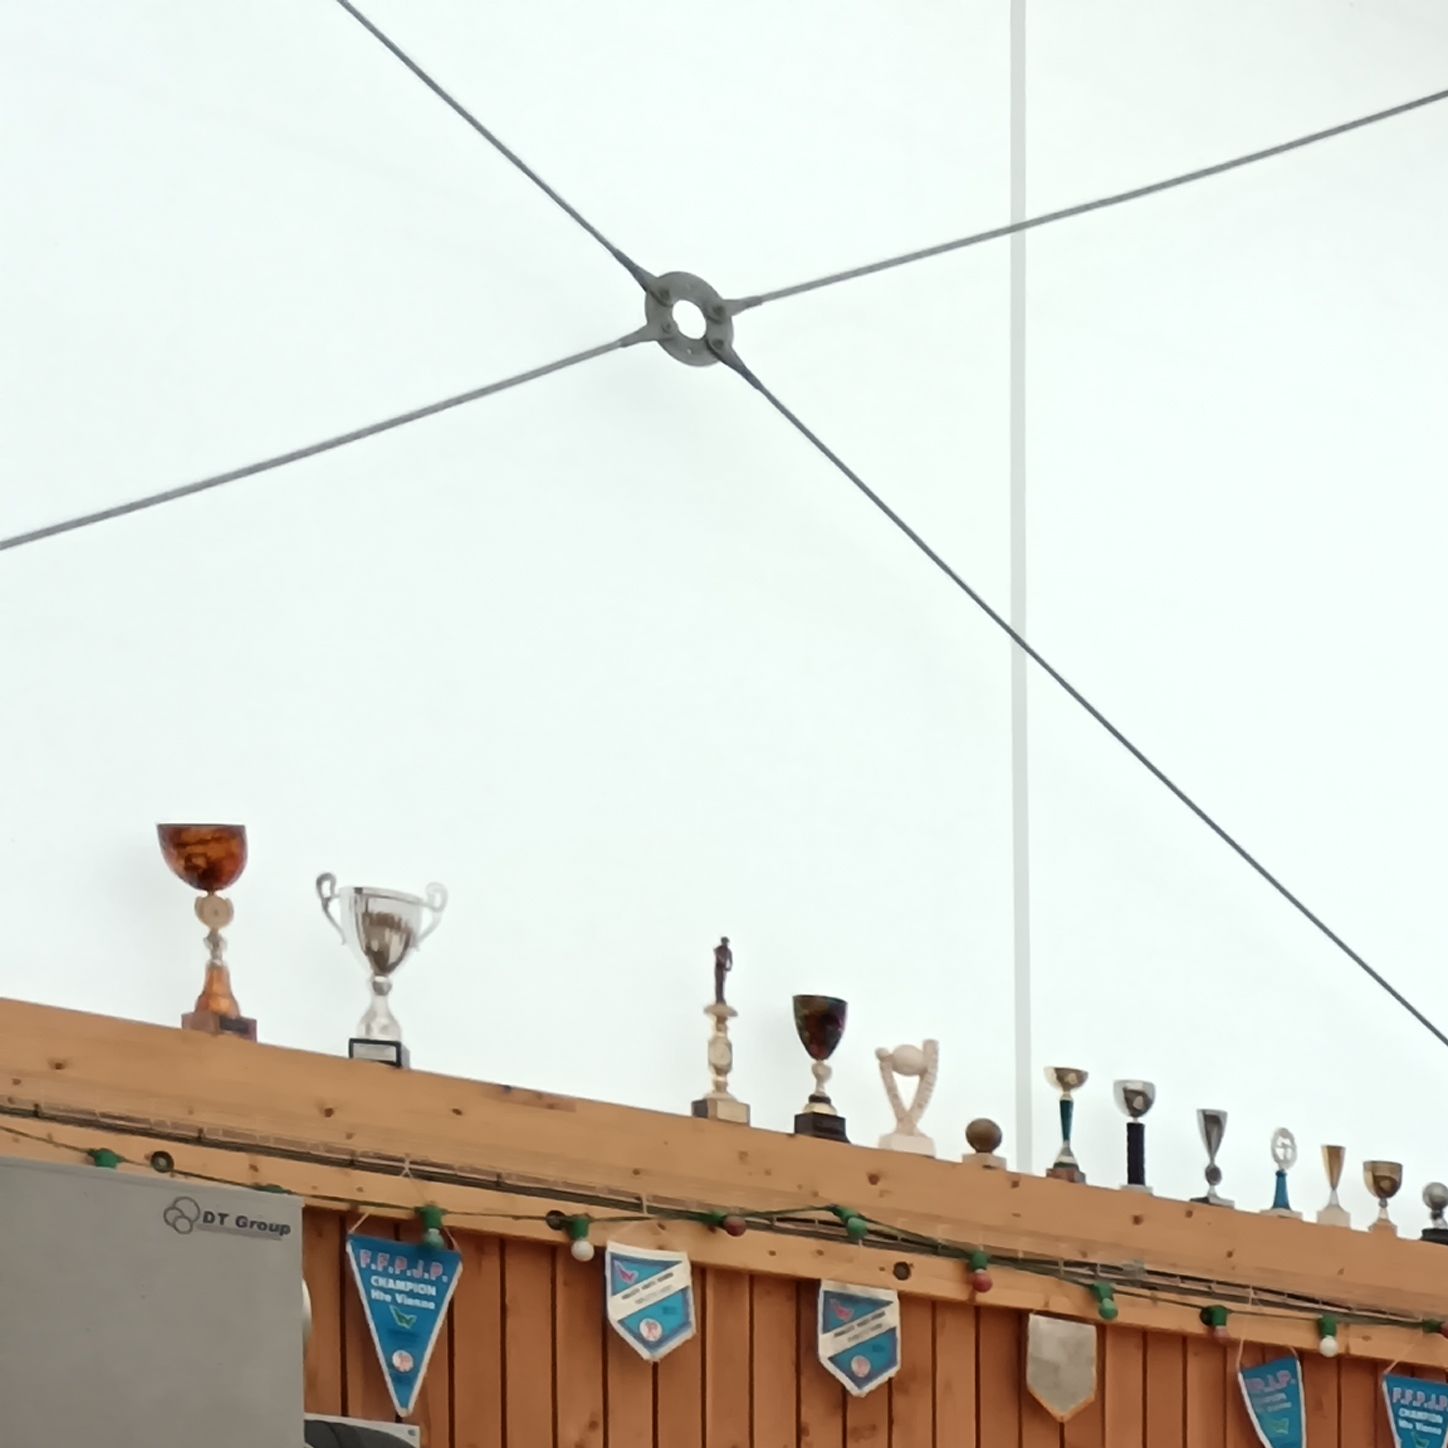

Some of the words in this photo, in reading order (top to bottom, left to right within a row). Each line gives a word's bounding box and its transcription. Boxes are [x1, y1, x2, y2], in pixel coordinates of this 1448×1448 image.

[203, 1210, 229, 1226] DT
[235, 1214, 291, 1237] Group
[359, 1249, 448, 1283] F.F.P.J.P.
[370, 1275, 436, 1296] CHAMPION
